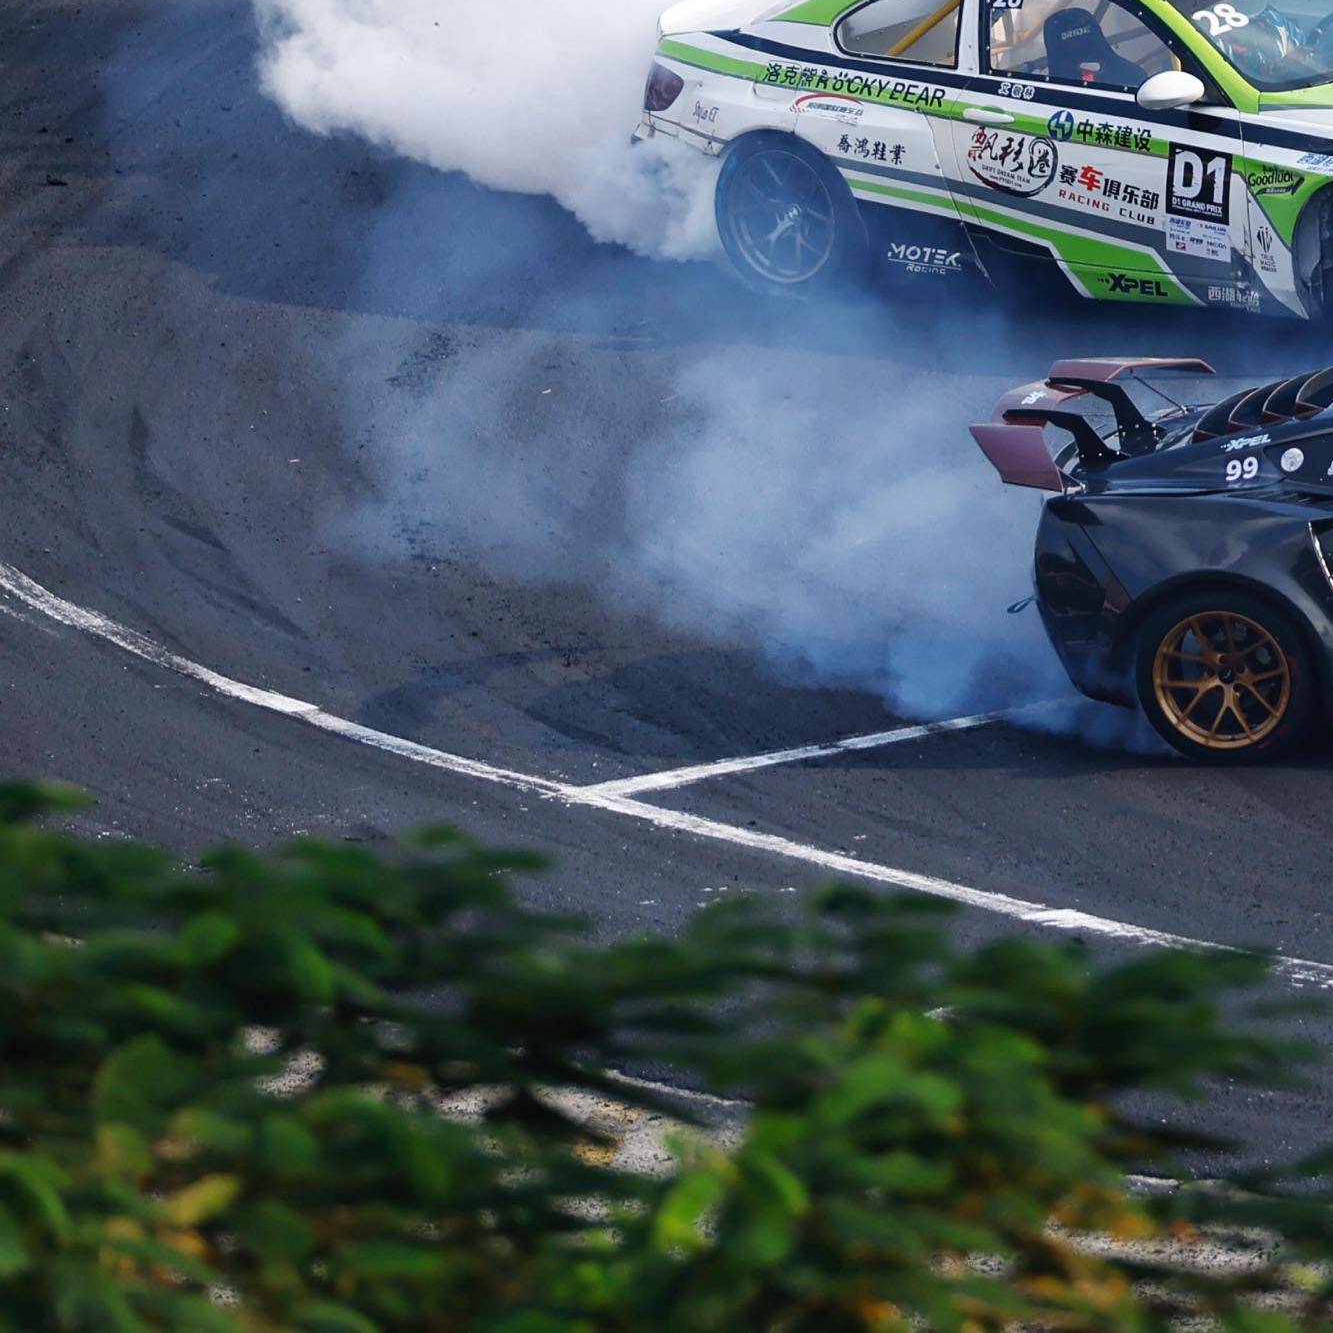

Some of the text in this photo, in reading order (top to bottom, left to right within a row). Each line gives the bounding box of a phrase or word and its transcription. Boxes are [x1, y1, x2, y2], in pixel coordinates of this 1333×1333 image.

[1192, 3, 1249, 37] 28
[889, 82, 946, 108] BEAR
[1076, 119, 1152, 152] 中森建设
[1059, 164, 1160, 211] 赛车俱乐部
[1173, 149, 1227, 204] D1
[1059, 188, 1110, 212] RACING
[1119, 207, 1155, 226] CLUB
[1182, 198, 1206, 211] GRAND
[1206, 203, 1223, 215] PRIX
[1107, 272, 1169, 297] XPEL
[1225, 433, 1272, 452] XPEL
[1225, 456, 1259, 482] 99
